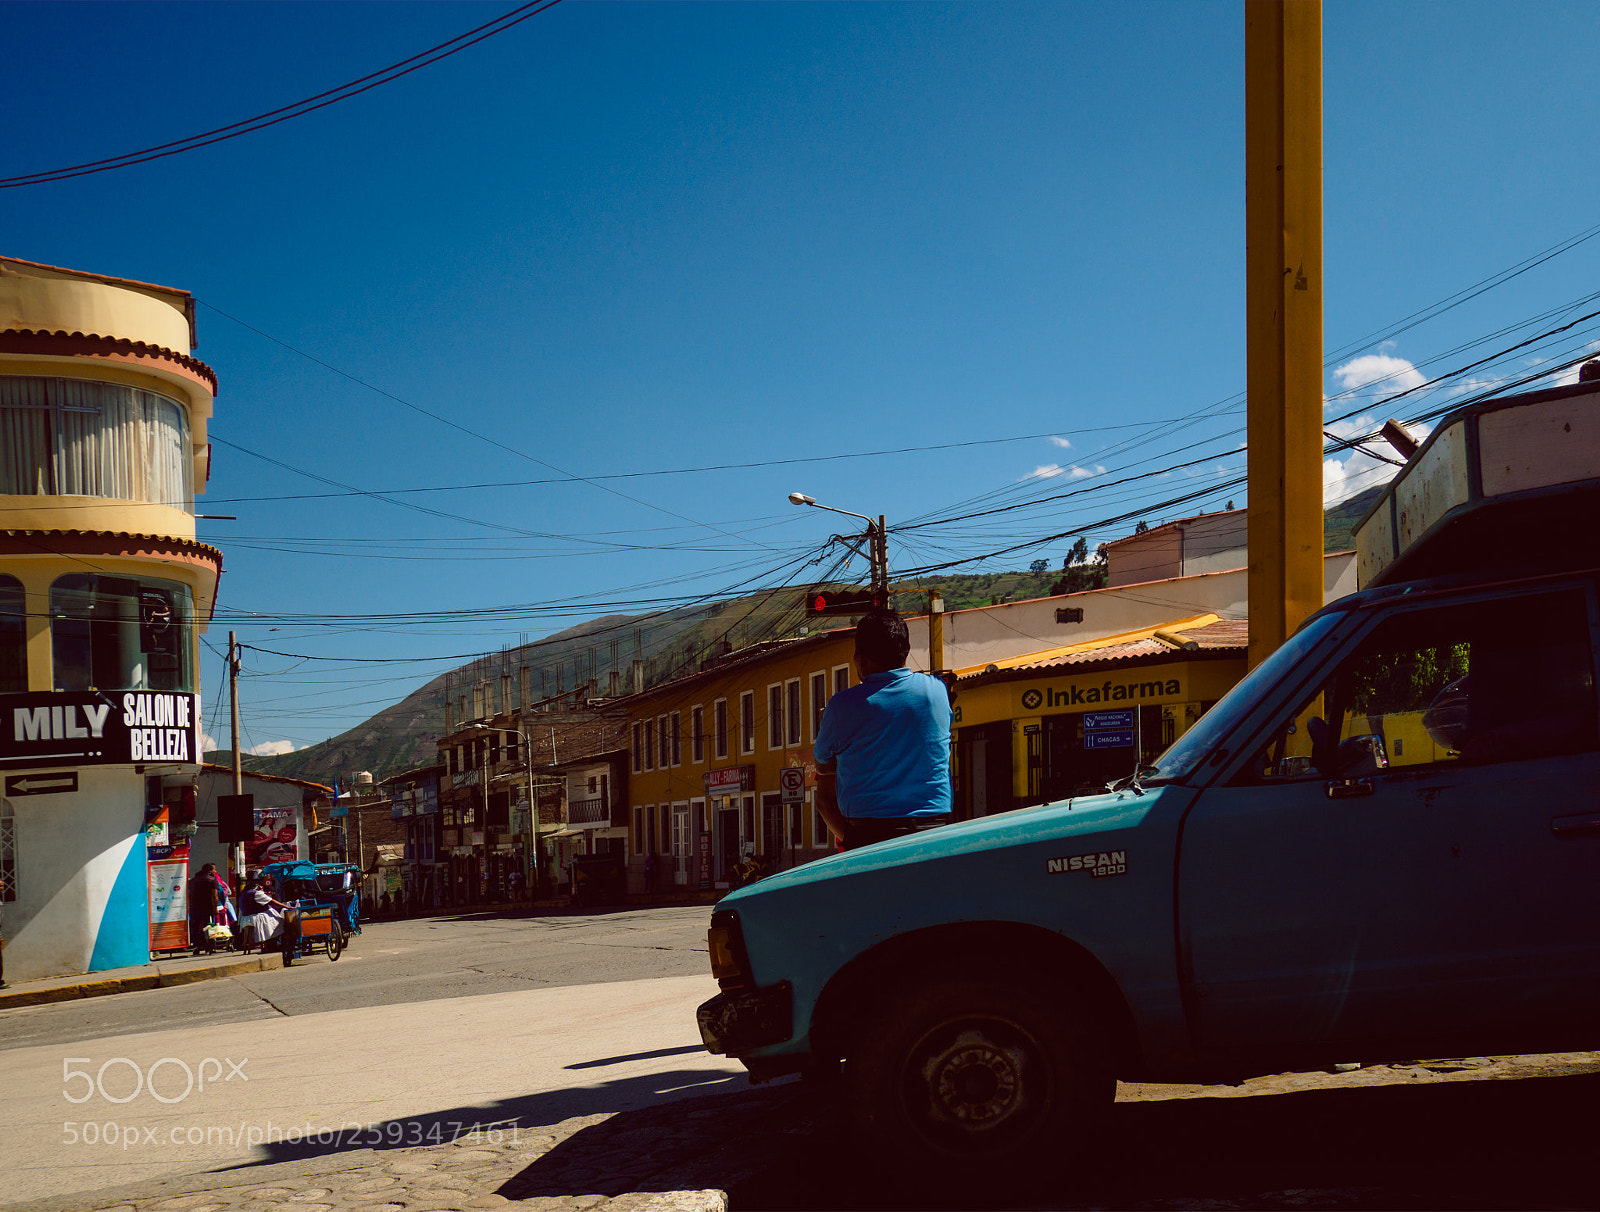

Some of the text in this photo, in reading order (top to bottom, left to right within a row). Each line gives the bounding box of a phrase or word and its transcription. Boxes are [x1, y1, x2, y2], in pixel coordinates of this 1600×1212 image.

[1047, 679, 1180, 707] Inkafarma
[14, 704, 110, 741] MILY
[123, 693, 190, 727] SALON DE
[131, 729, 188, 761] BELLEZA
[1048, 850, 1125, 873] NISSAN
